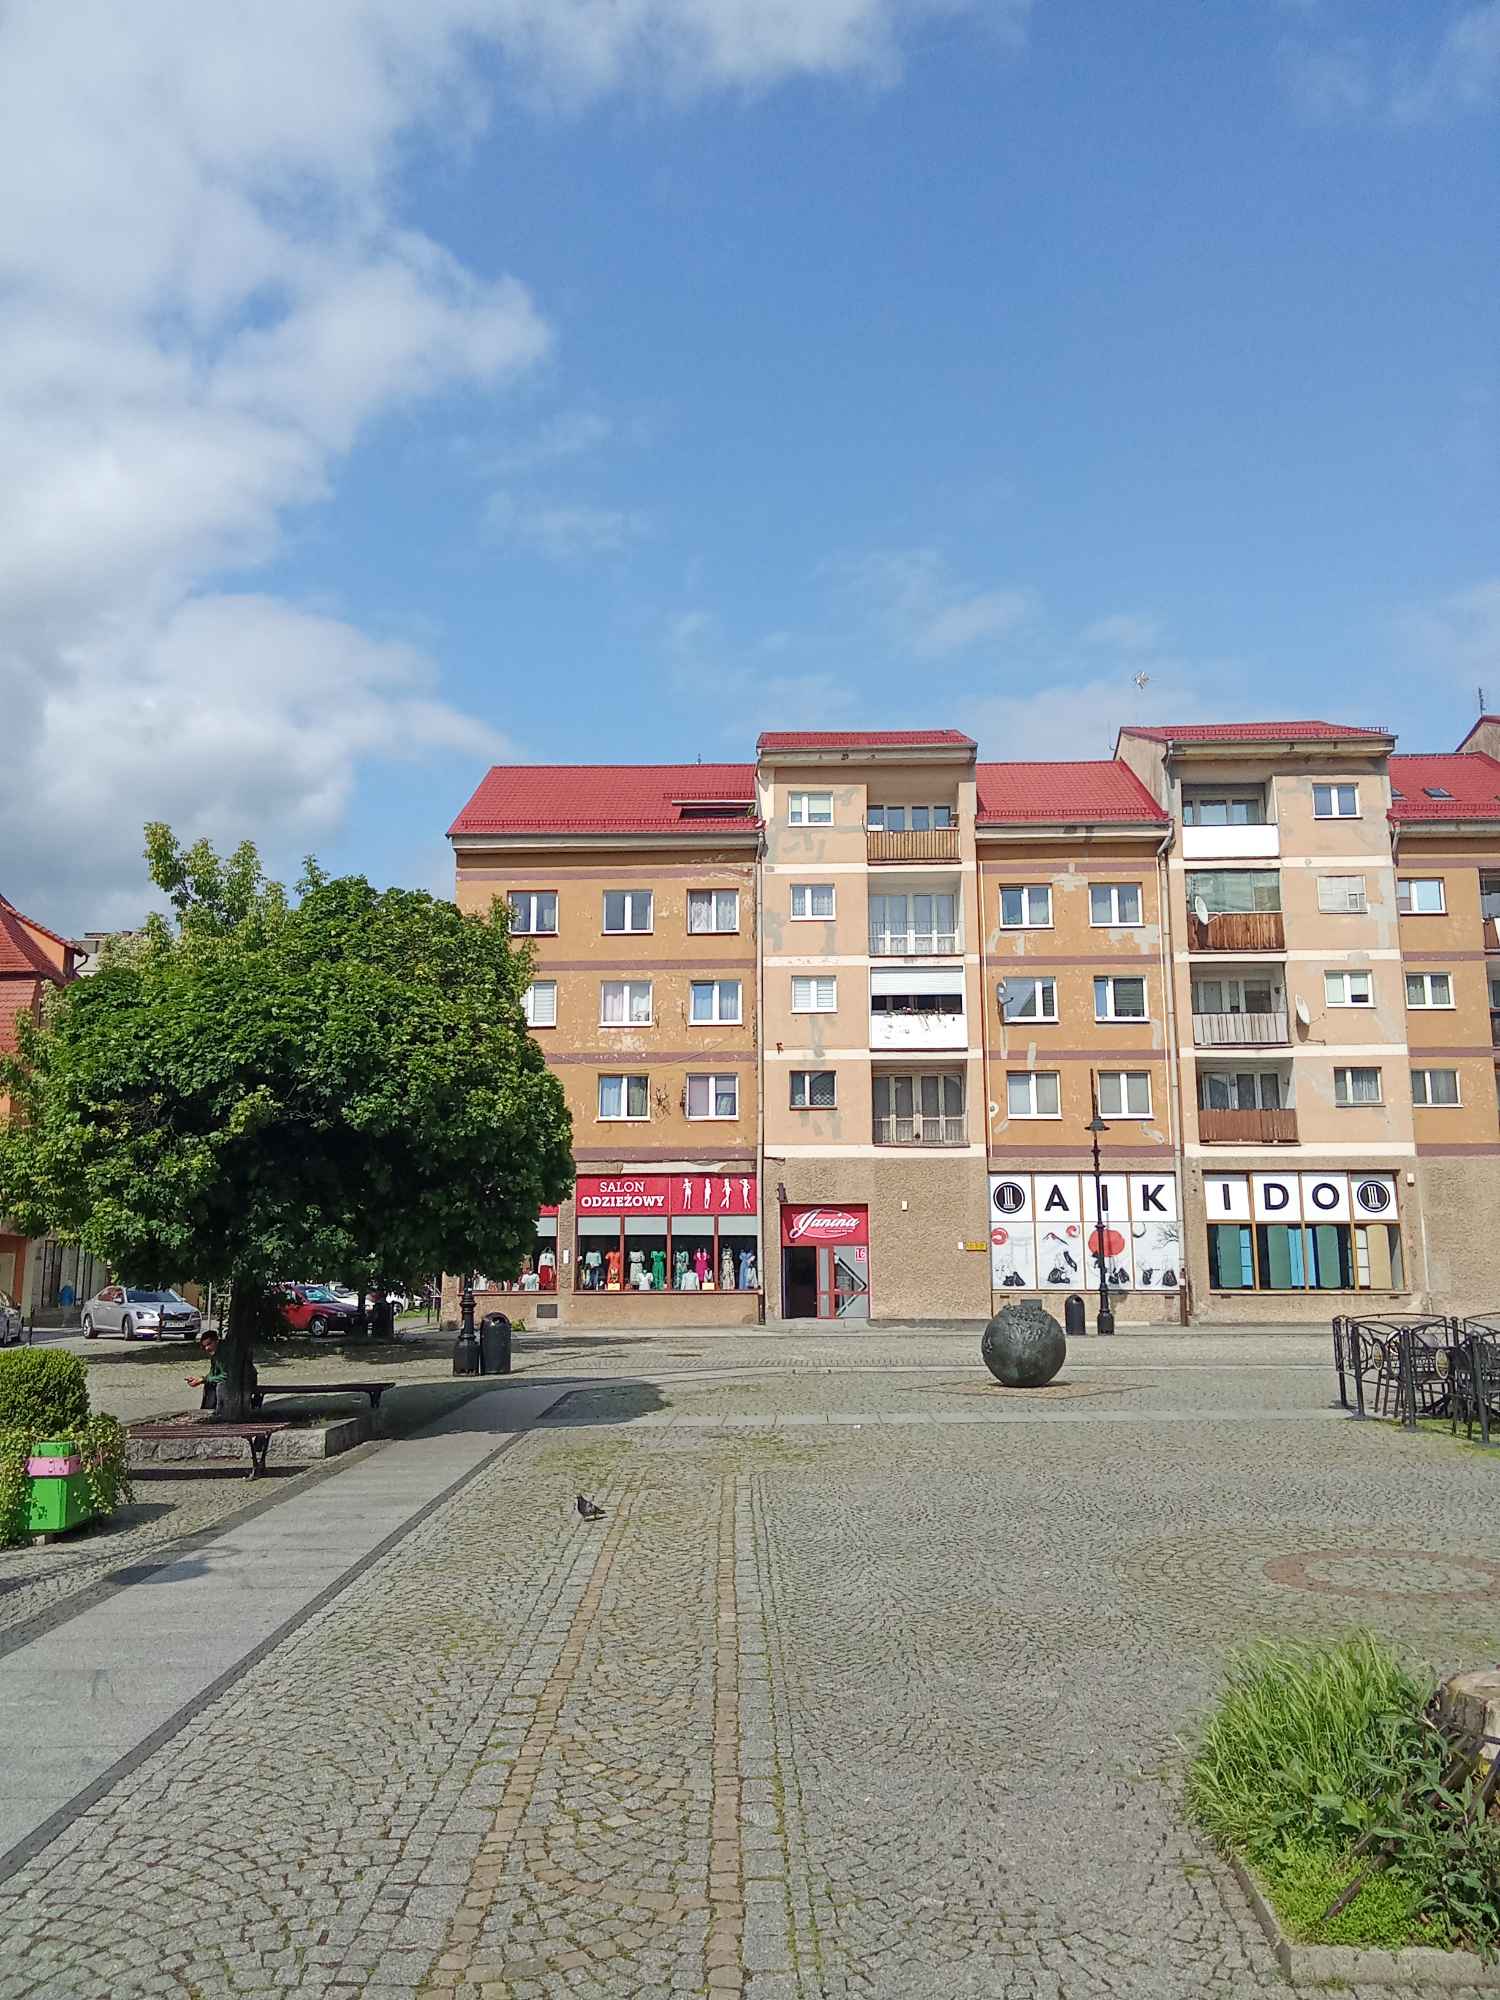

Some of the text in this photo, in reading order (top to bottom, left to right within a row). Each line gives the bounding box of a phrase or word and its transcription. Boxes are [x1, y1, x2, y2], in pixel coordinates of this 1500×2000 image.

[600, 1181, 645, 1193] SALON
[581, 1193, 664, 1207] ODZIEŻOWY
[856, 1248, 865, 1259] 16
